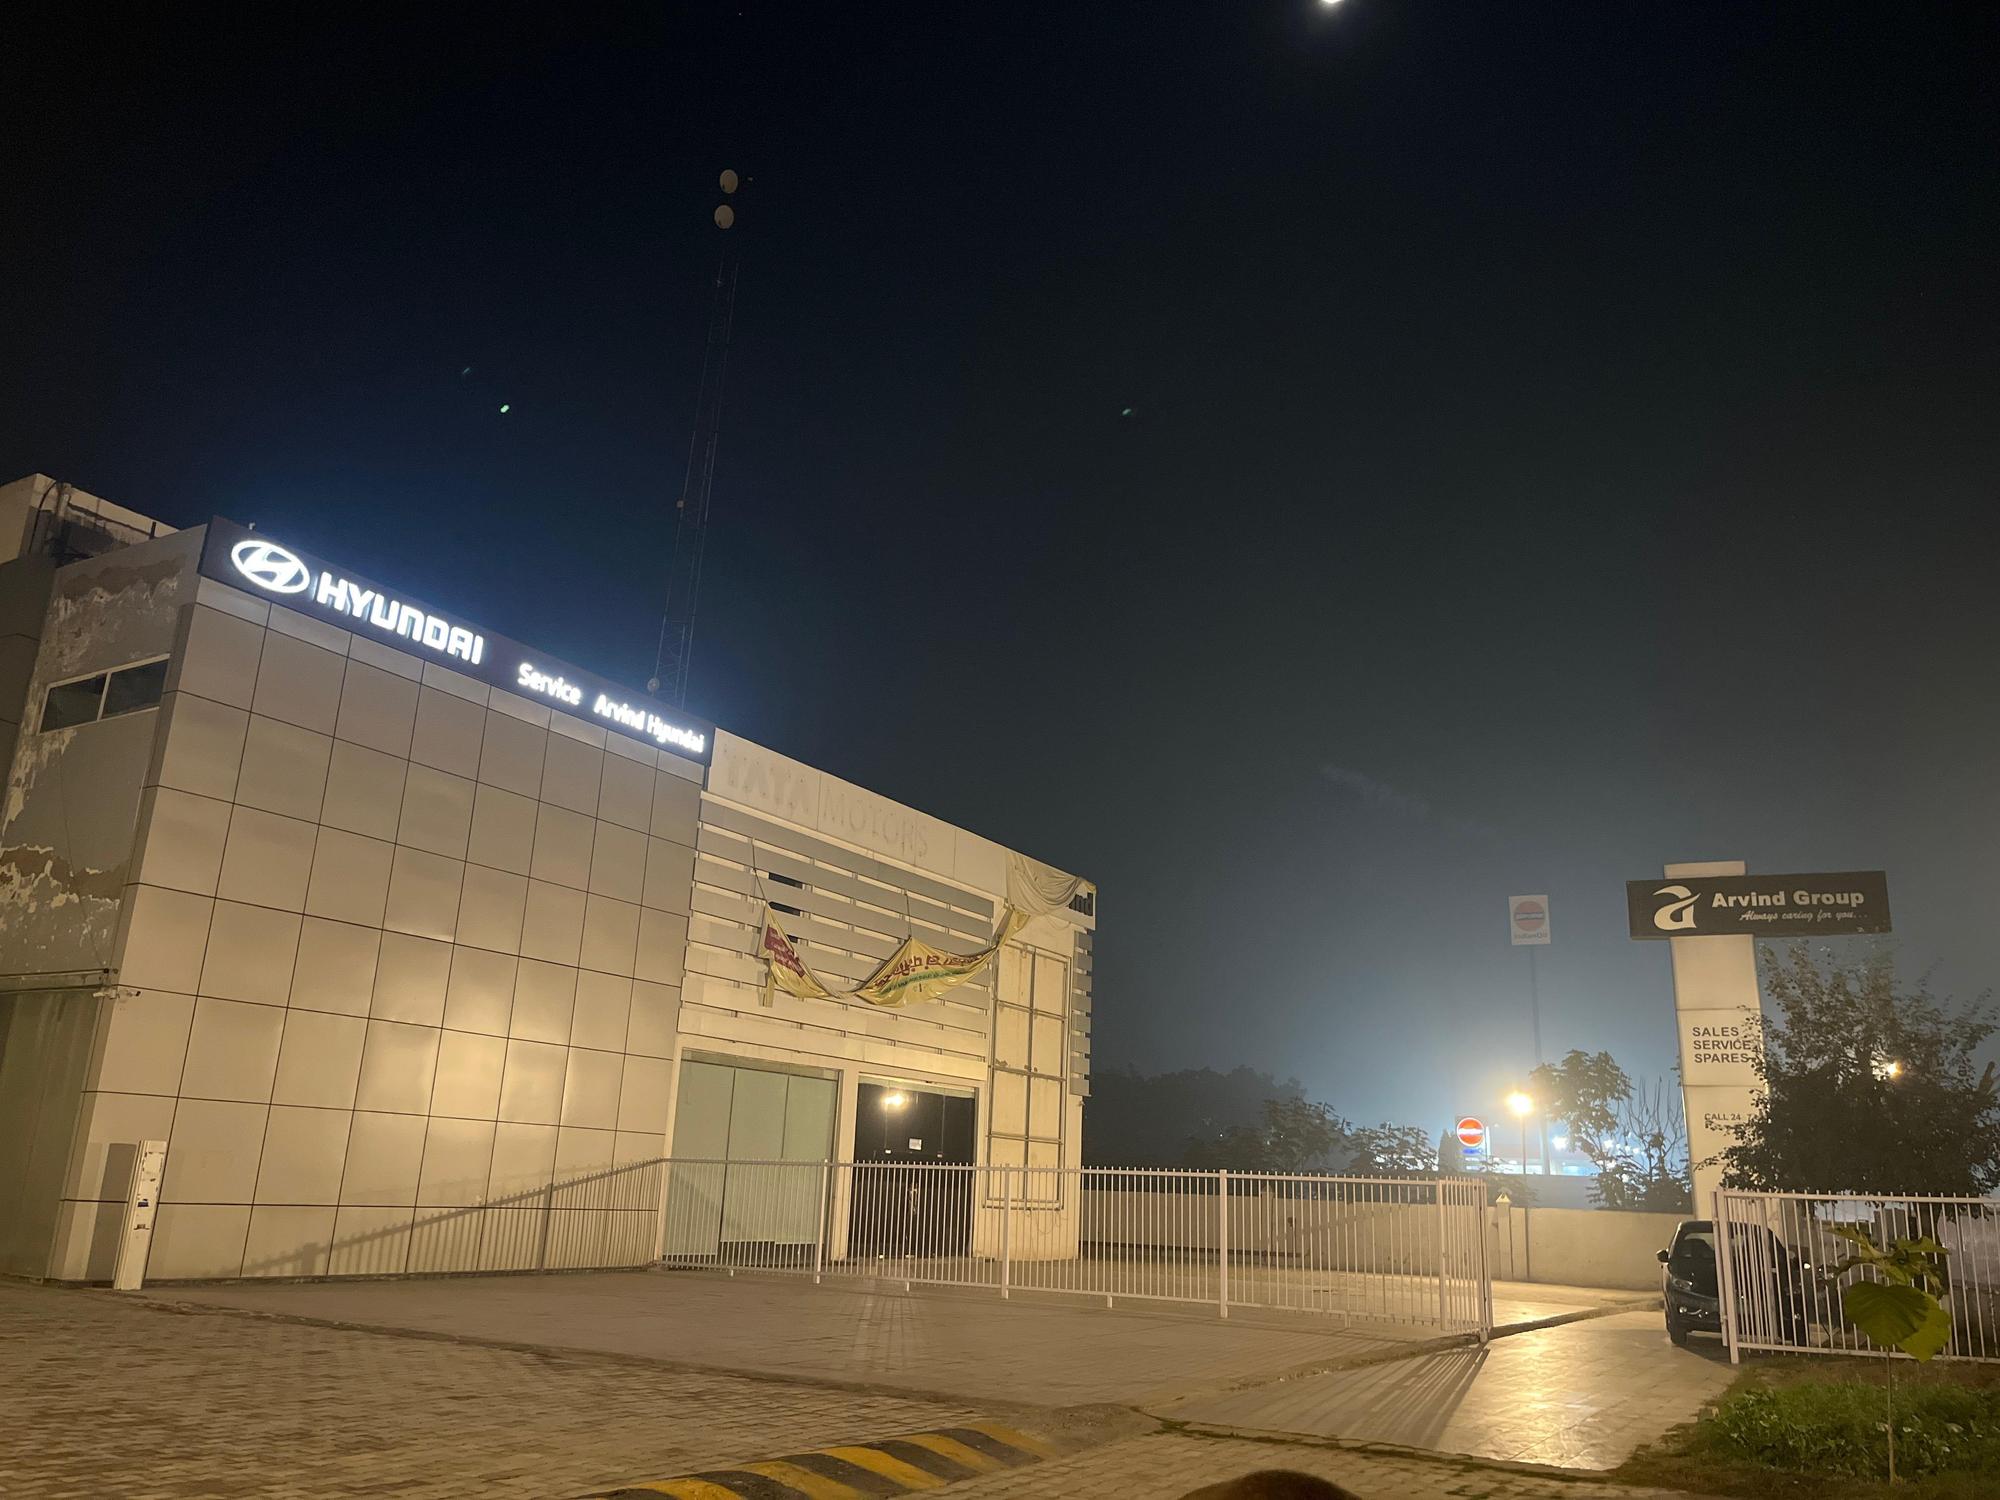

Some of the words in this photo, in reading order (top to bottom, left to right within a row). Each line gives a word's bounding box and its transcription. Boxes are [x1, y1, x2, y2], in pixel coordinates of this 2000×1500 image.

[316, 571, 484, 665] HYUNDAI
[518, 663, 582, 707] Service
[593, 693, 645, 731] Arvind
[646, 713, 706, 754] Hyundai
[1711, 892, 1786, 908] Arvind
[1793, 890, 1865, 907] Group
[1738, 910, 1778, 923] Always
[1782, 912, 1813, 923] caring
[1816, 909, 1832, 923] for
[1692, 1027, 1739, 1037] SALES
[1693, 1040, 1751, 1050] SERVICE
[1694, 1053, 1749, 1063] SPARES
[1704, 1113, 1728, 1121] CALL
[1730, 1113, 1741, 1121] 24
